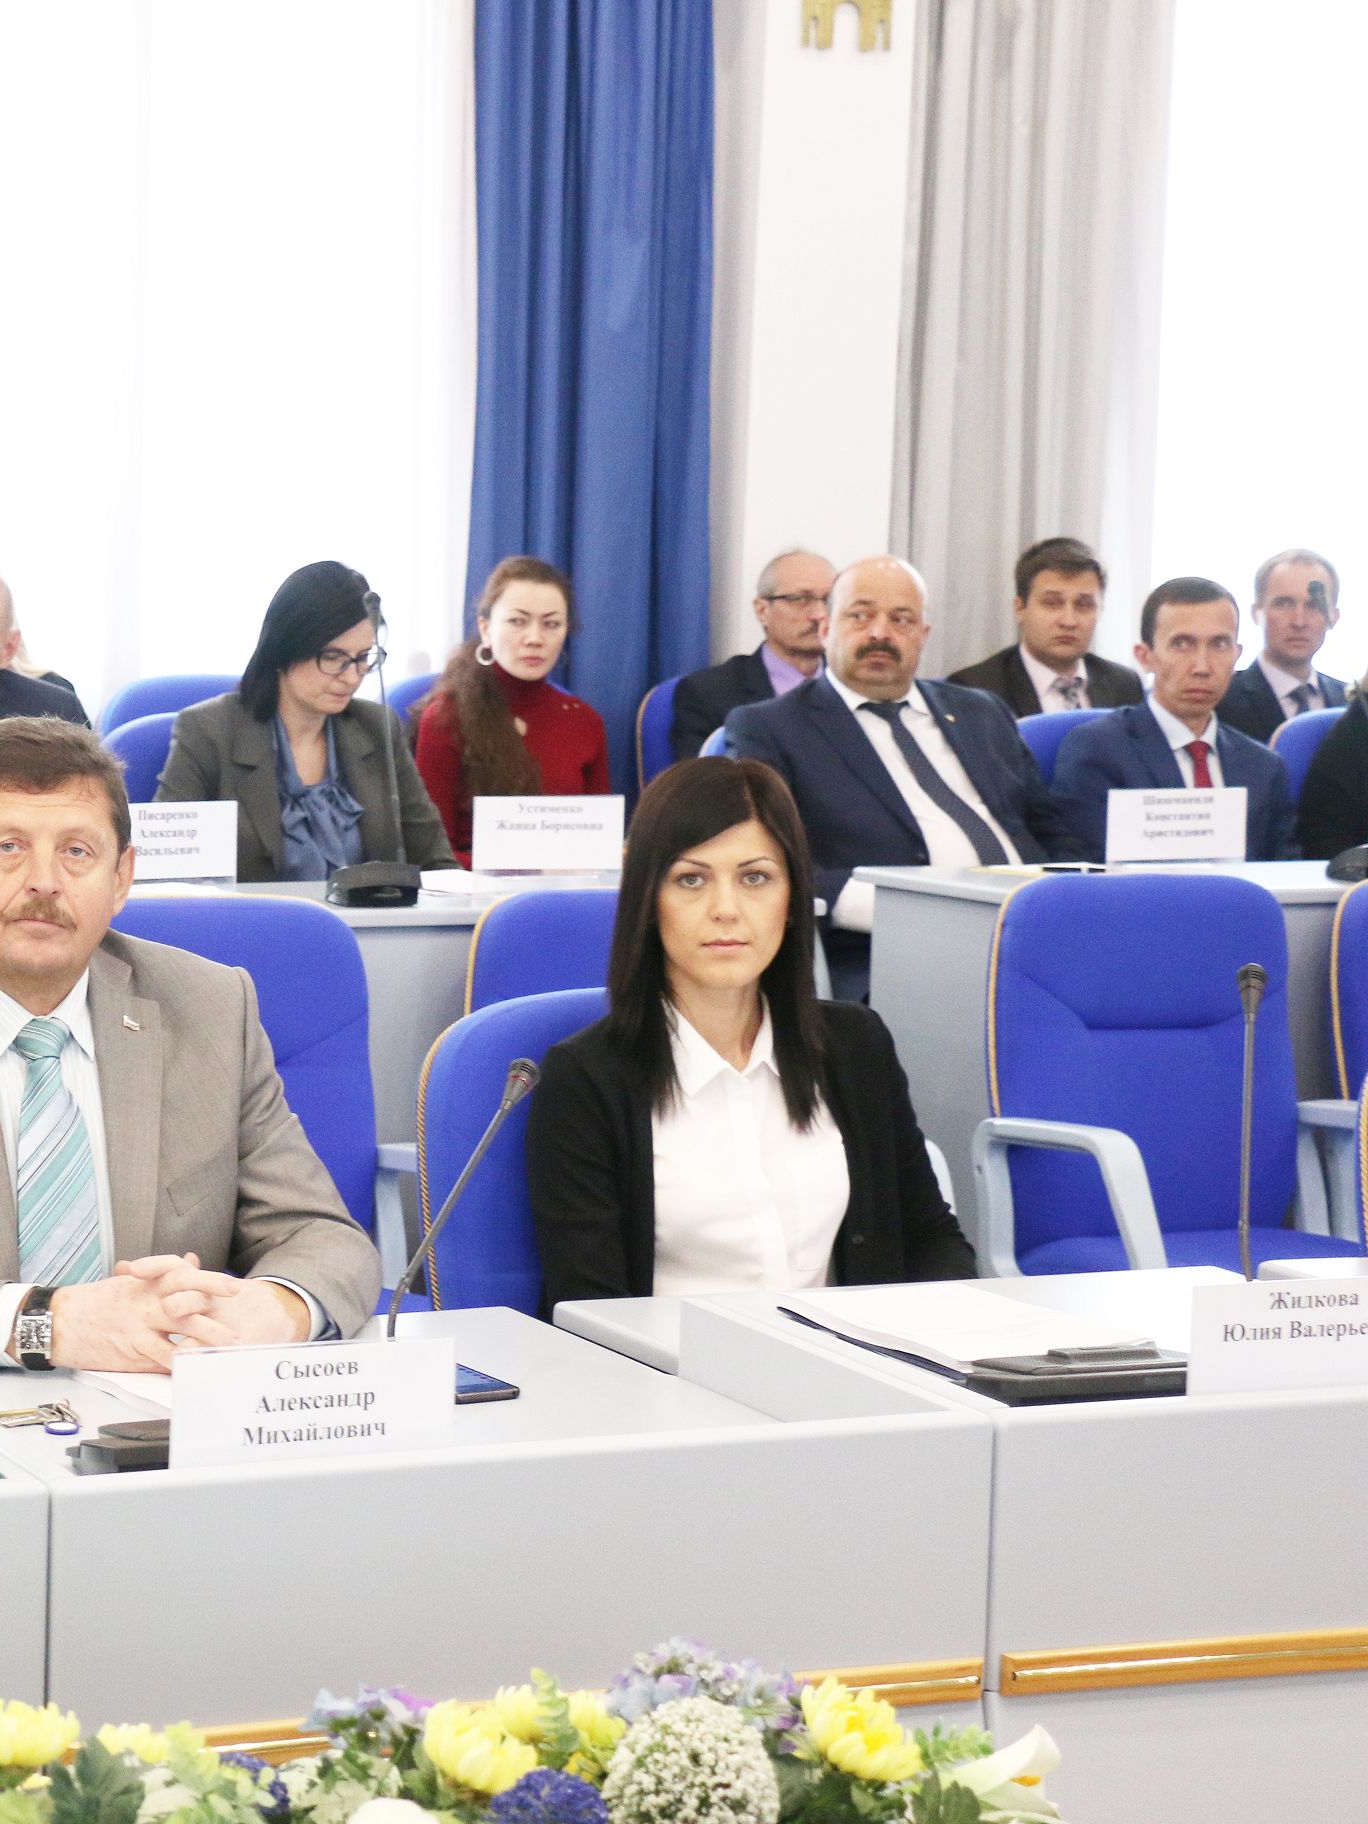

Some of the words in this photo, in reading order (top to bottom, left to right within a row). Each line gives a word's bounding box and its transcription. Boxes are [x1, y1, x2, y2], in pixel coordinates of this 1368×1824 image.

[138, 809, 199, 823] Писаренко
[139, 828, 198, 841] Александр
[540, 820, 604, 833] Борисовна
[134, 845, 201, 857] Васильевич
[1268, 1291, 1360, 1310] Жидкова
[1223, 1323, 1282, 1342] Юлия
[274, 1359, 359, 1381] Сысоев
[255, 1390, 376, 1414] Александр
[241, 1421, 387, 1447] Михайлович
